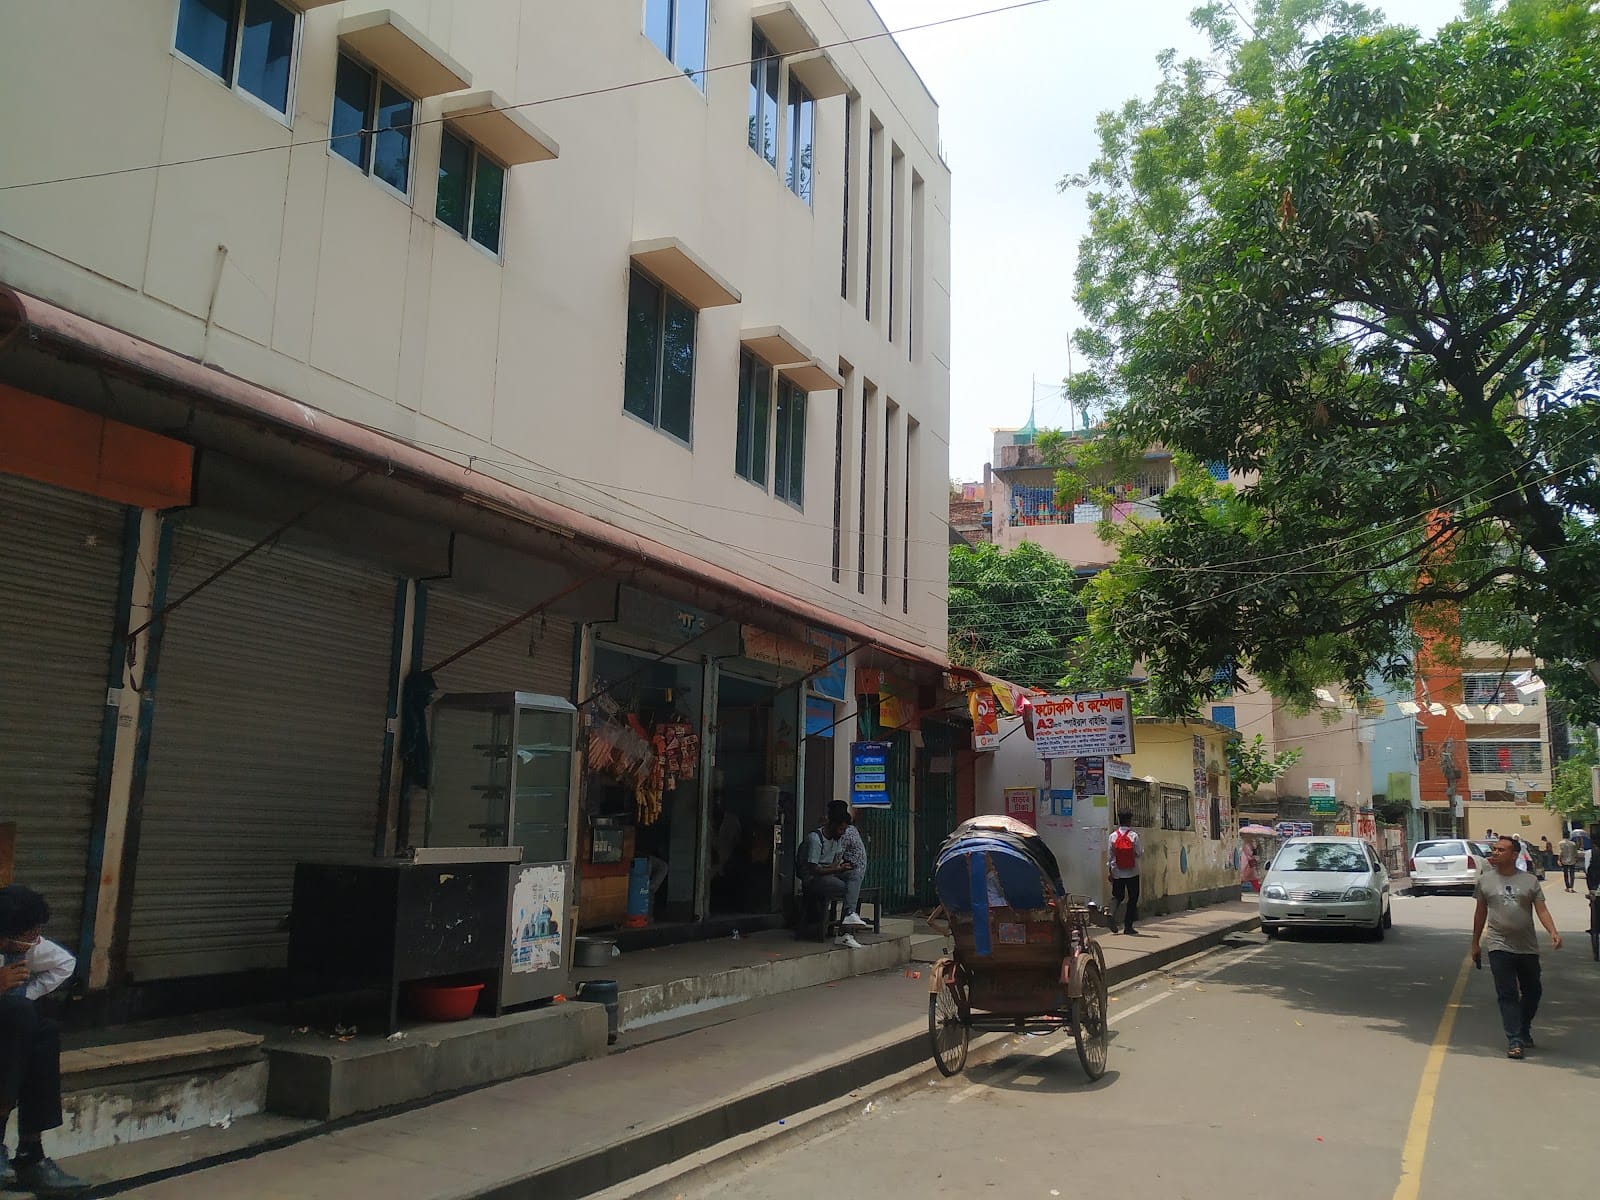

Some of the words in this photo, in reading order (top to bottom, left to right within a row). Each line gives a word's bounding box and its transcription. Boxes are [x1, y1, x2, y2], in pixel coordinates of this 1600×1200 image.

[1034, 698, 1074, 717] ফটোকপি
[1076, 701, 1085, 713] ও
[1087, 697, 1124, 714] কম্পোজ
[1037, 718, 1054, 729] A3
